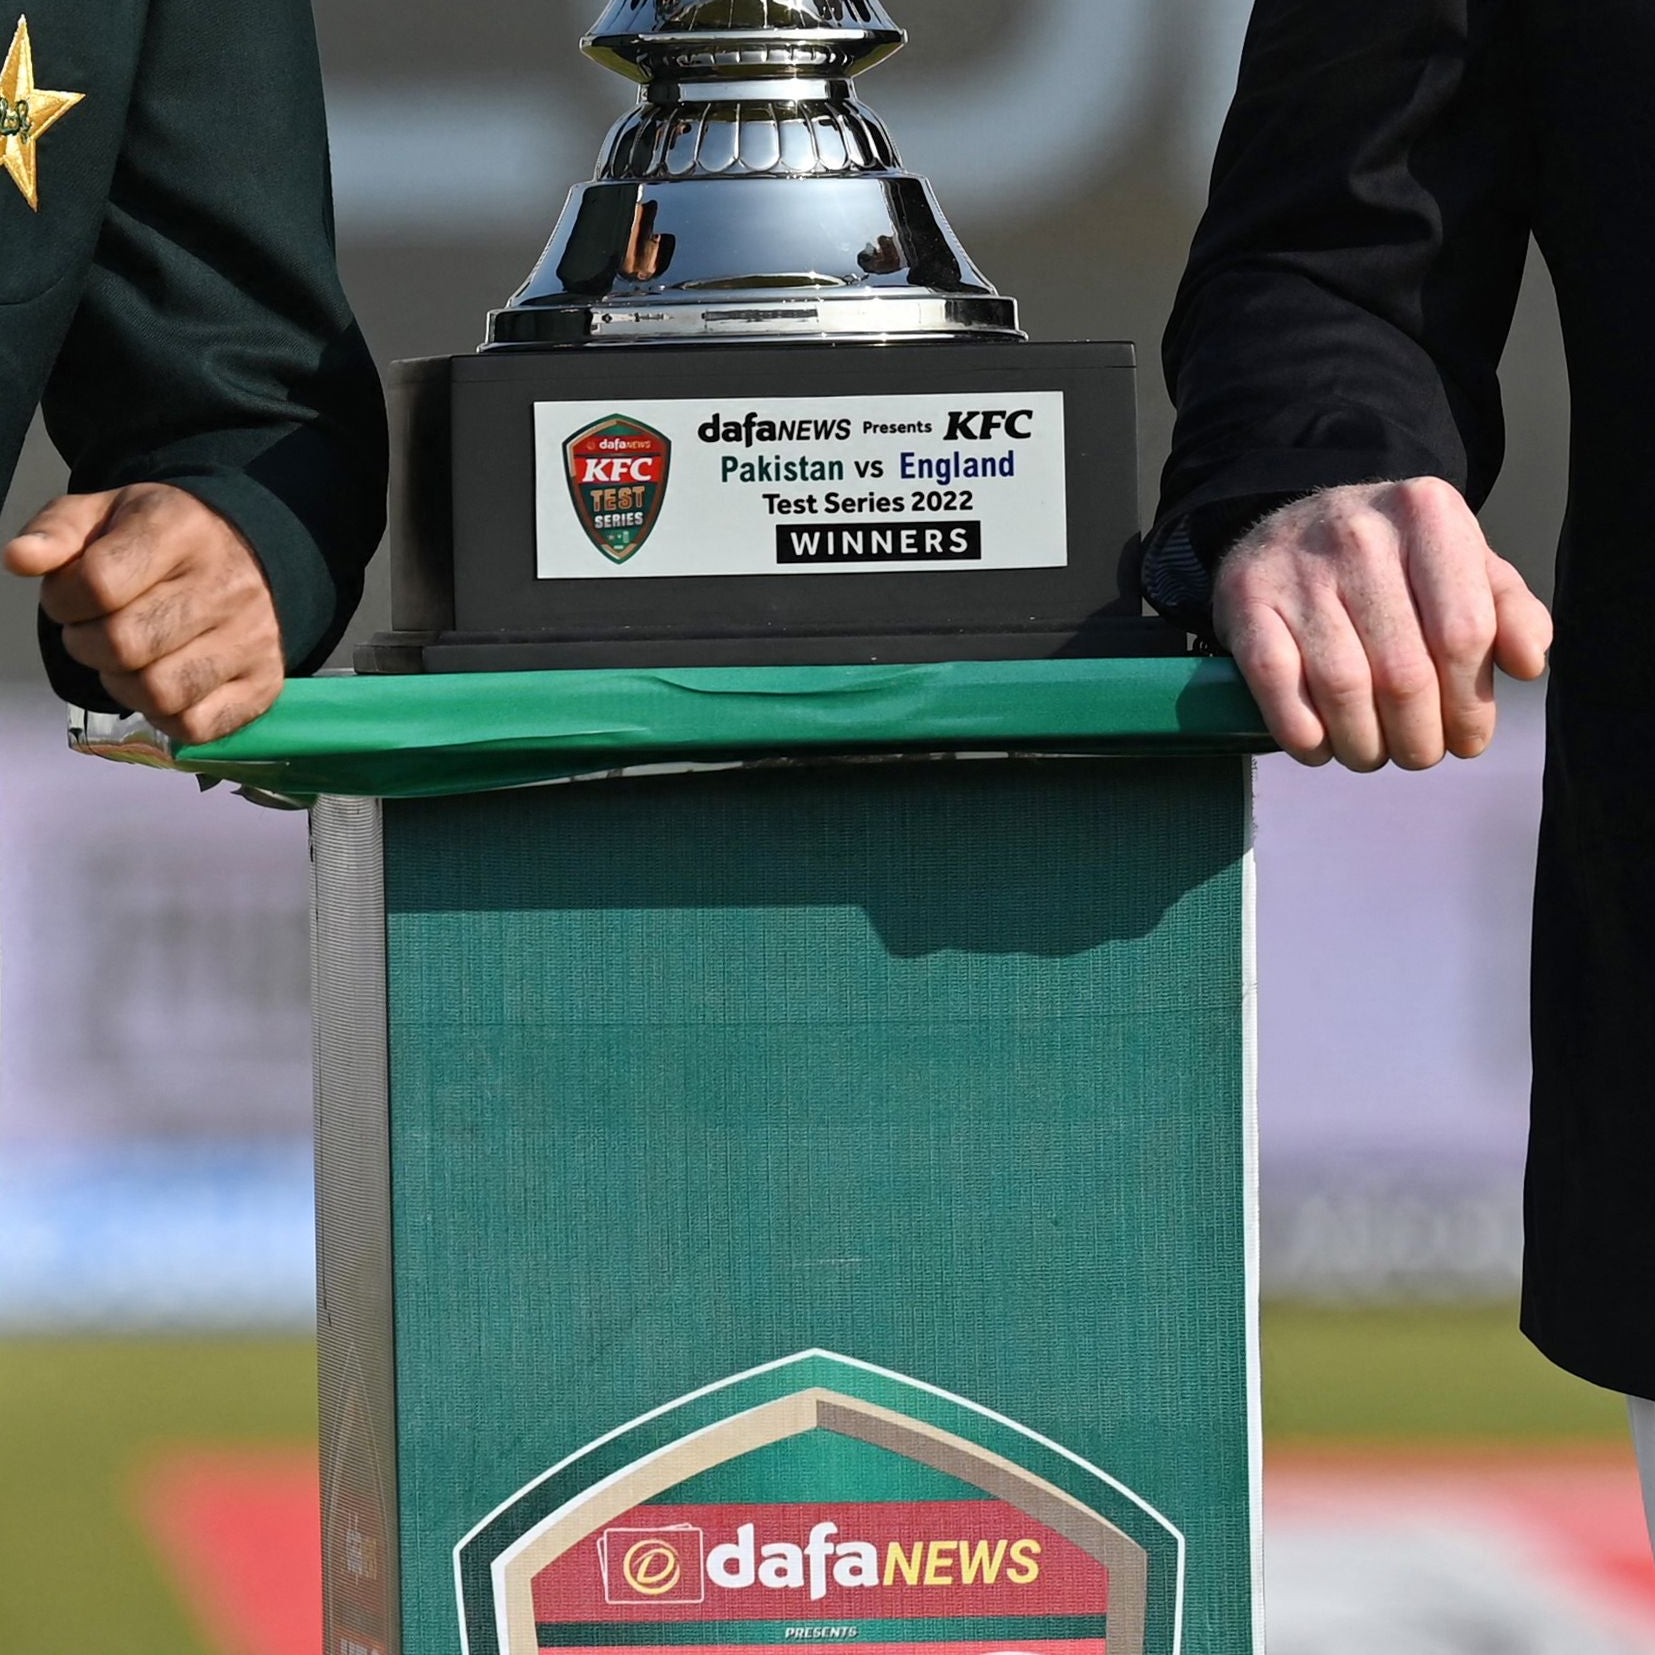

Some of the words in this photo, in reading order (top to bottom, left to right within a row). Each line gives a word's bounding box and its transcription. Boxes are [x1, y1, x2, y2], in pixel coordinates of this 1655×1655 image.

[697, 411, 851, 448] dafaNEWS
[862, 421, 933, 434] Presents
[943, 409, 1034, 441] KFC
[582, 457, 653, 482] KFC
[721, 455, 844, 483] Pakistan
[854, 460, 884, 479] vs
[900, 450, 1015, 485] England
[590, 486, 646, 512] TEST
[762, 493, 818, 515] Test
[824, 492, 905, 514] Series
[911, 490, 974, 512] 2022
[594, 511, 643, 529] SERIES
[790, 527, 969, 556] WINNERS
[706, 1521, 1042, 1602] dafaNEWS
[784, 1625, 859, 1639] PRESENTS
